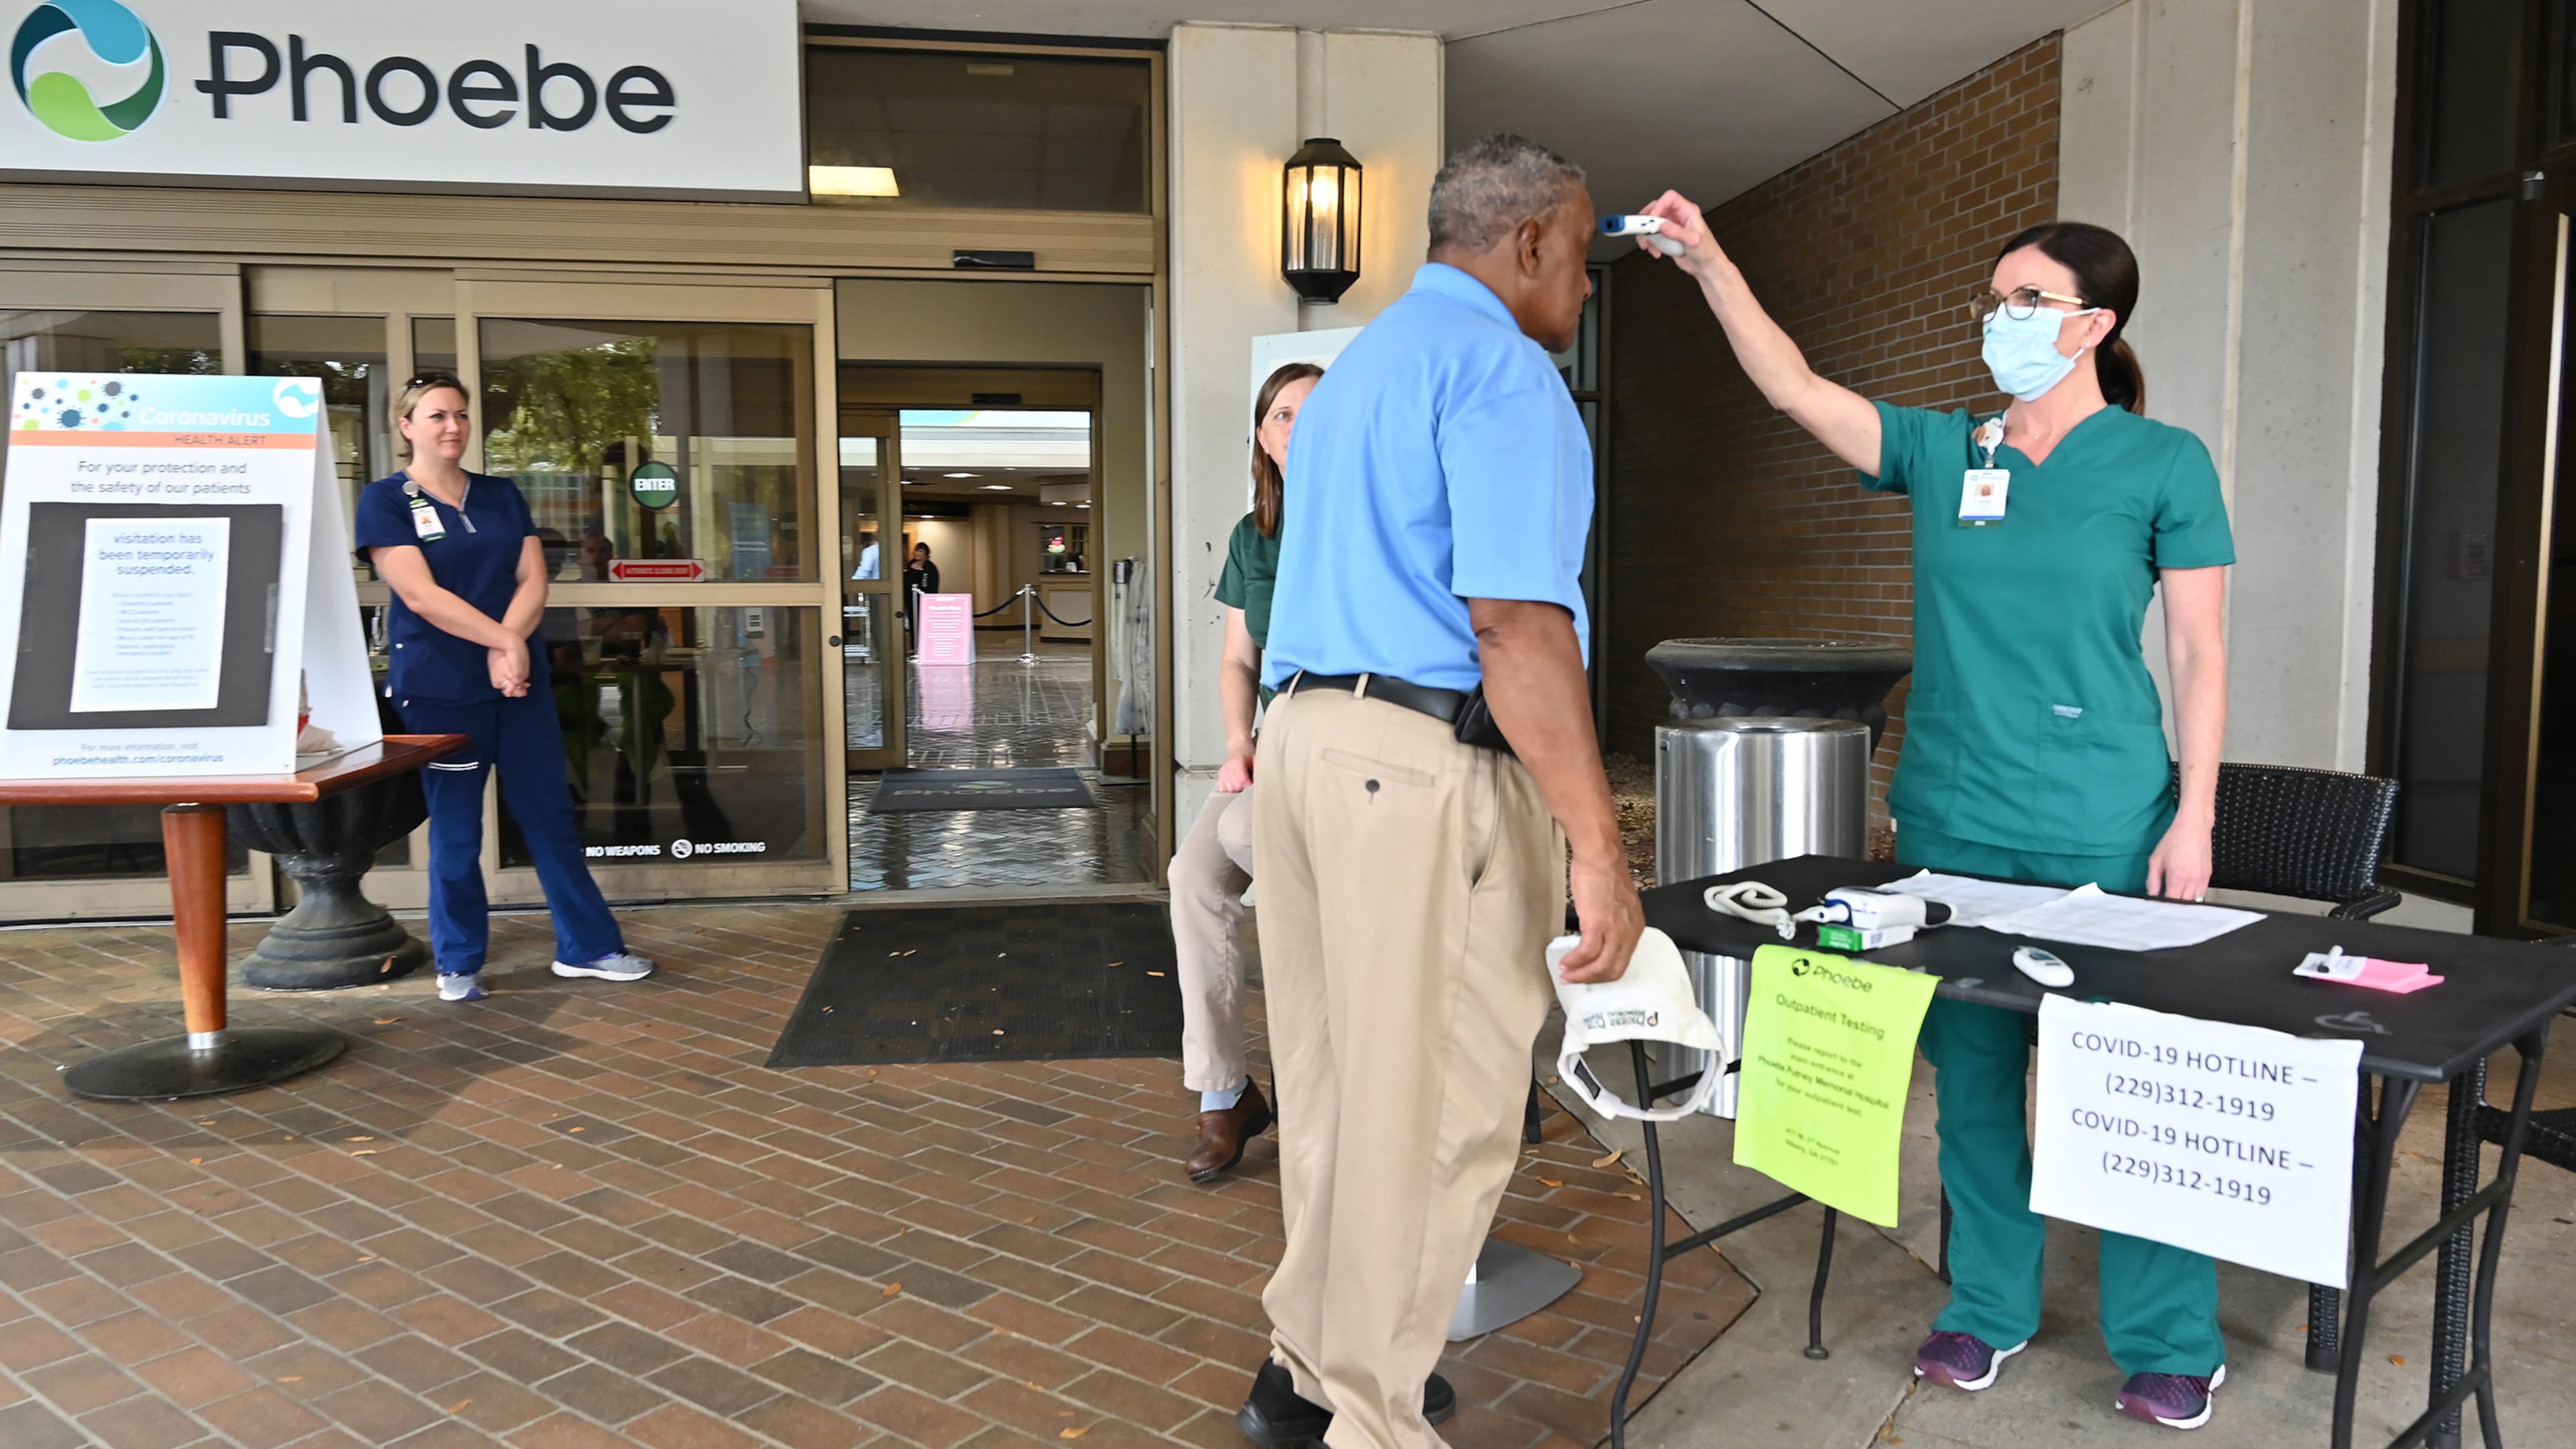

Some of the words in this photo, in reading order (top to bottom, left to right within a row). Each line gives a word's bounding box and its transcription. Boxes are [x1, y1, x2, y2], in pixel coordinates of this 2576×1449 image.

[195, 30, 675, 134] Phoebe
[140, 407, 270, 427] Coronavirus
[175, 434, 223, 445] HEALTH
[227, 435, 266, 445] ALERT
[78, 461, 101, 472] For
[105, 463, 138, 475] your
[142, 461, 216, 475] protection
[220, 462, 248, 474] and
[70, 482, 94, 493] the
[99, 482, 143, 496] safety
[147, 482, 162, 493] of
[165, 484, 189, 494] our
[193, 482, 252, 496] patients
[634, 478, 676, 492] ENTER
[113, 532, 176, 544] visitation
[178, 533, 203, 543] has
[99, 549, 133, 560] been
[137, 549, 215, 562] temporarily
[584, 846, 604, 857] NO
[604, 845, 661, 857] WEAPONS
[694, 843, 713, 855] NO
[713, 841, 766, 854] SMOKING
[1813, 965, 1872, 993] Phoebe
[1776, 994, 1837, 1023] Outpatient
[1841, 1014, 1885, 1041] Testing
[2072, 1031, 2178, 1066] COVID-19
[2186, 1051, 2294, 1085] HOTLINE
[2105, 1071, 2275, 1122] (229)312-1919
[2072, 1108, 2176, 1146] COVID-19
[2185, 1131, 2291, 1171] HOTLINE
[2102, 1150, 2271, 1206] (229)312-1919
